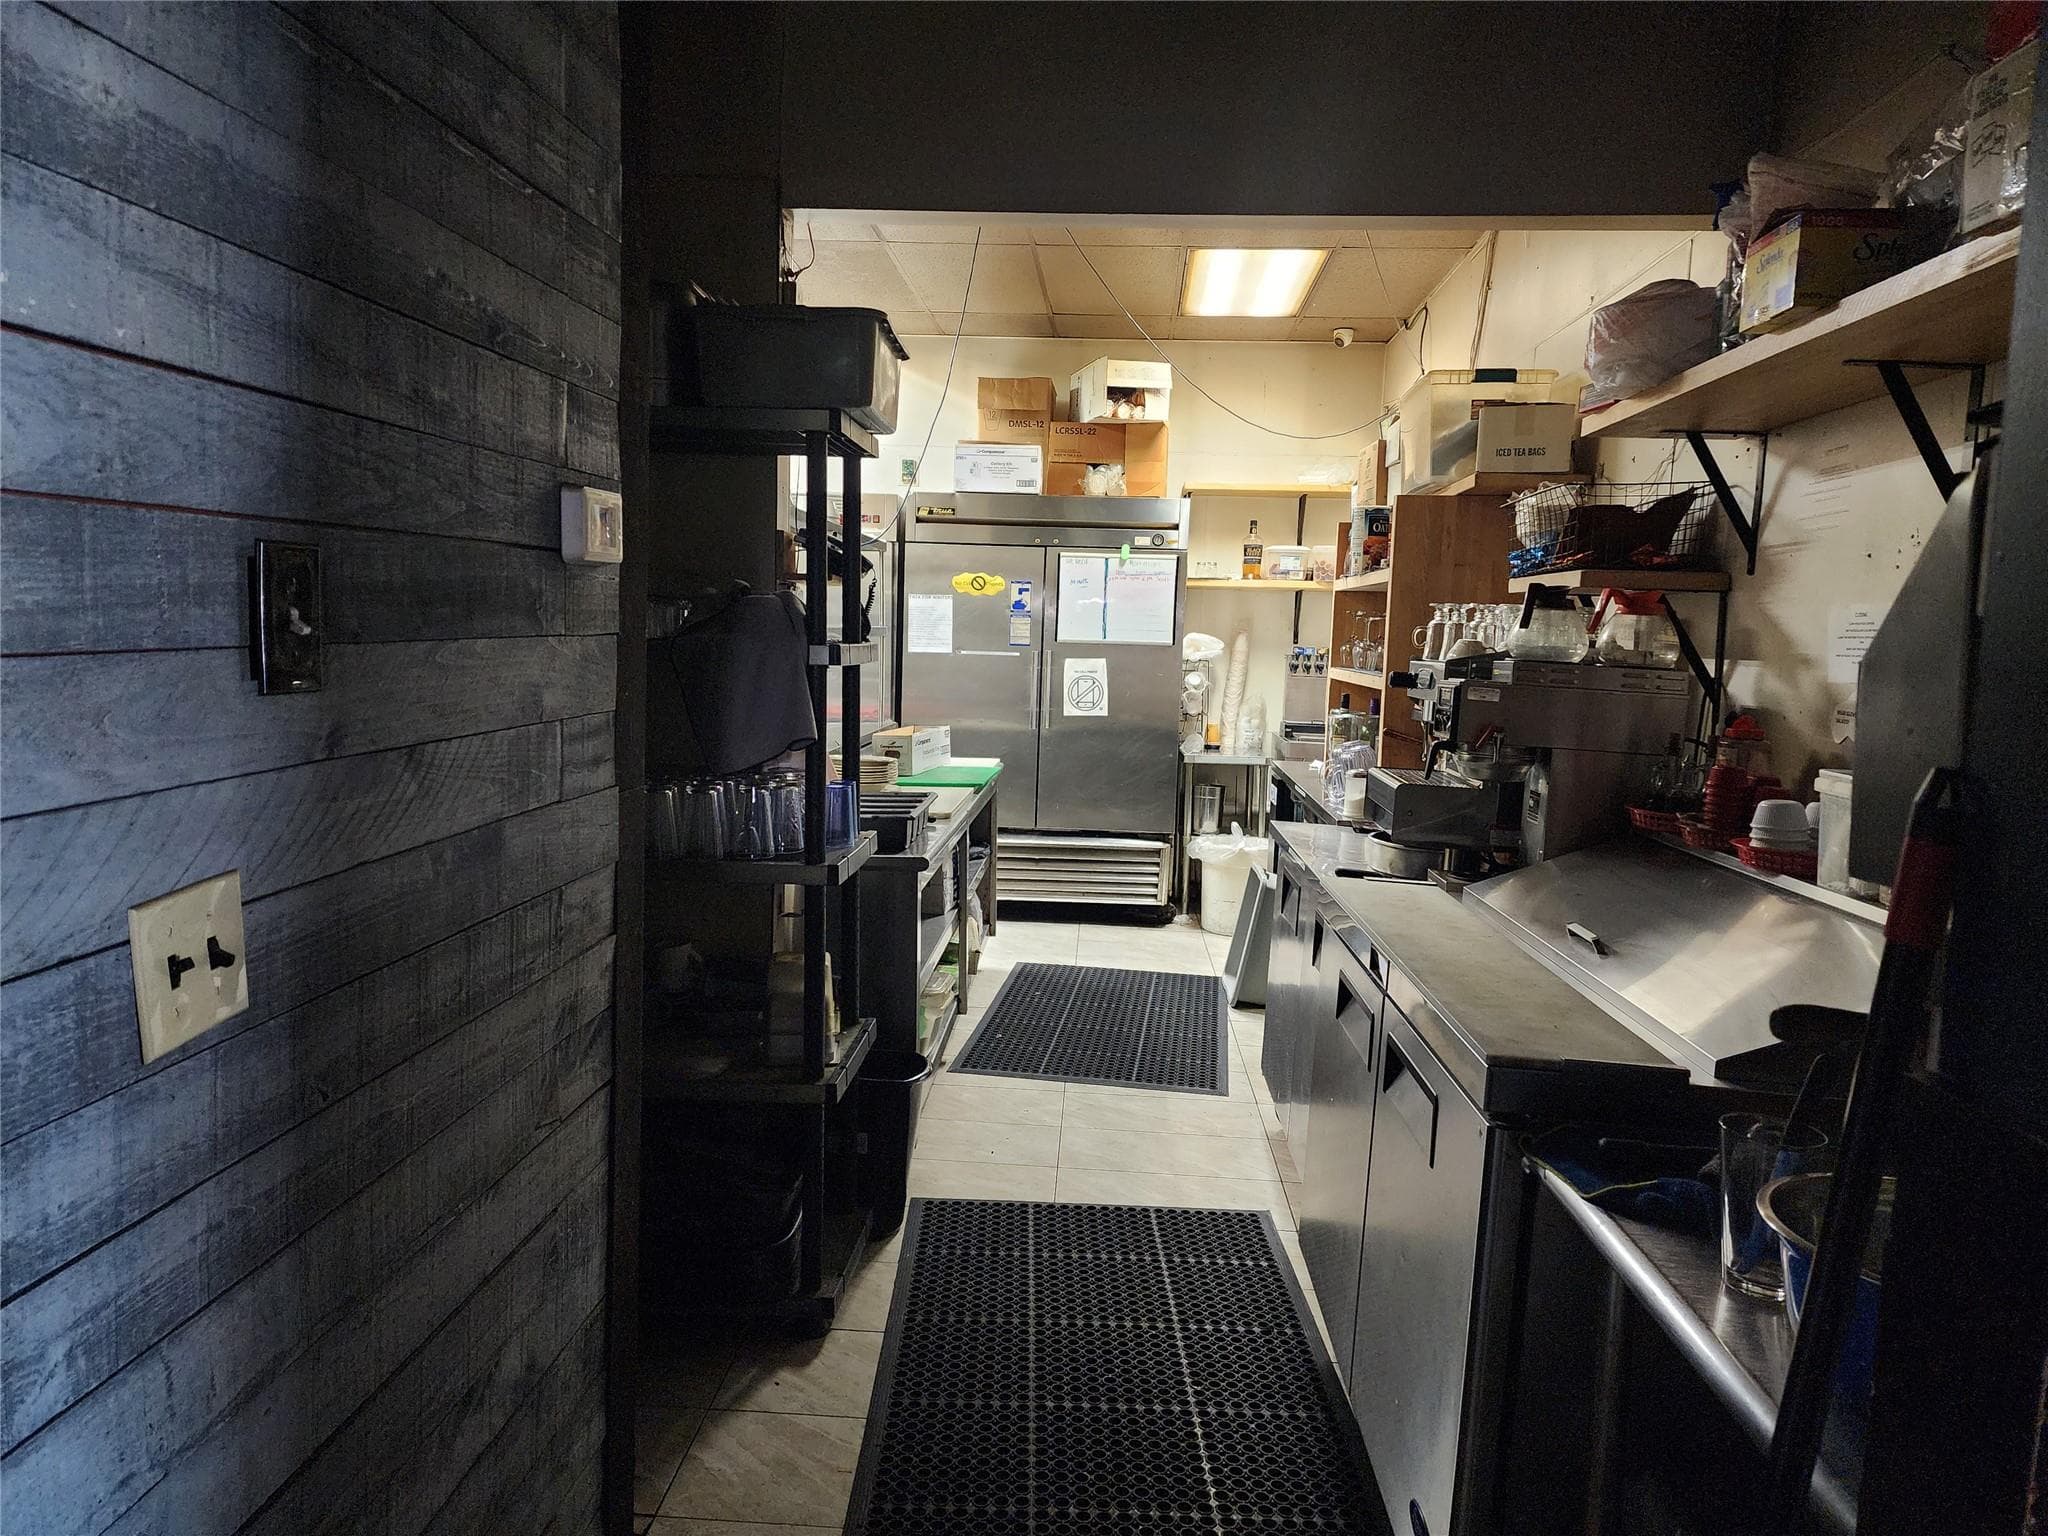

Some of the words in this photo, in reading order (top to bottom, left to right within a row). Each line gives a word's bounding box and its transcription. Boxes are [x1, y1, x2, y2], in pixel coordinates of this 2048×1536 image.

[1008, 420, 1045, 428] DMSL-12
[1055, 427, 1097, 436] LCRSSL-22
[1495, 448, 1512, 457] ICED
[1513, 447, 1526, 457] TEA
[1528, 446, 1546, 456] BAGS
